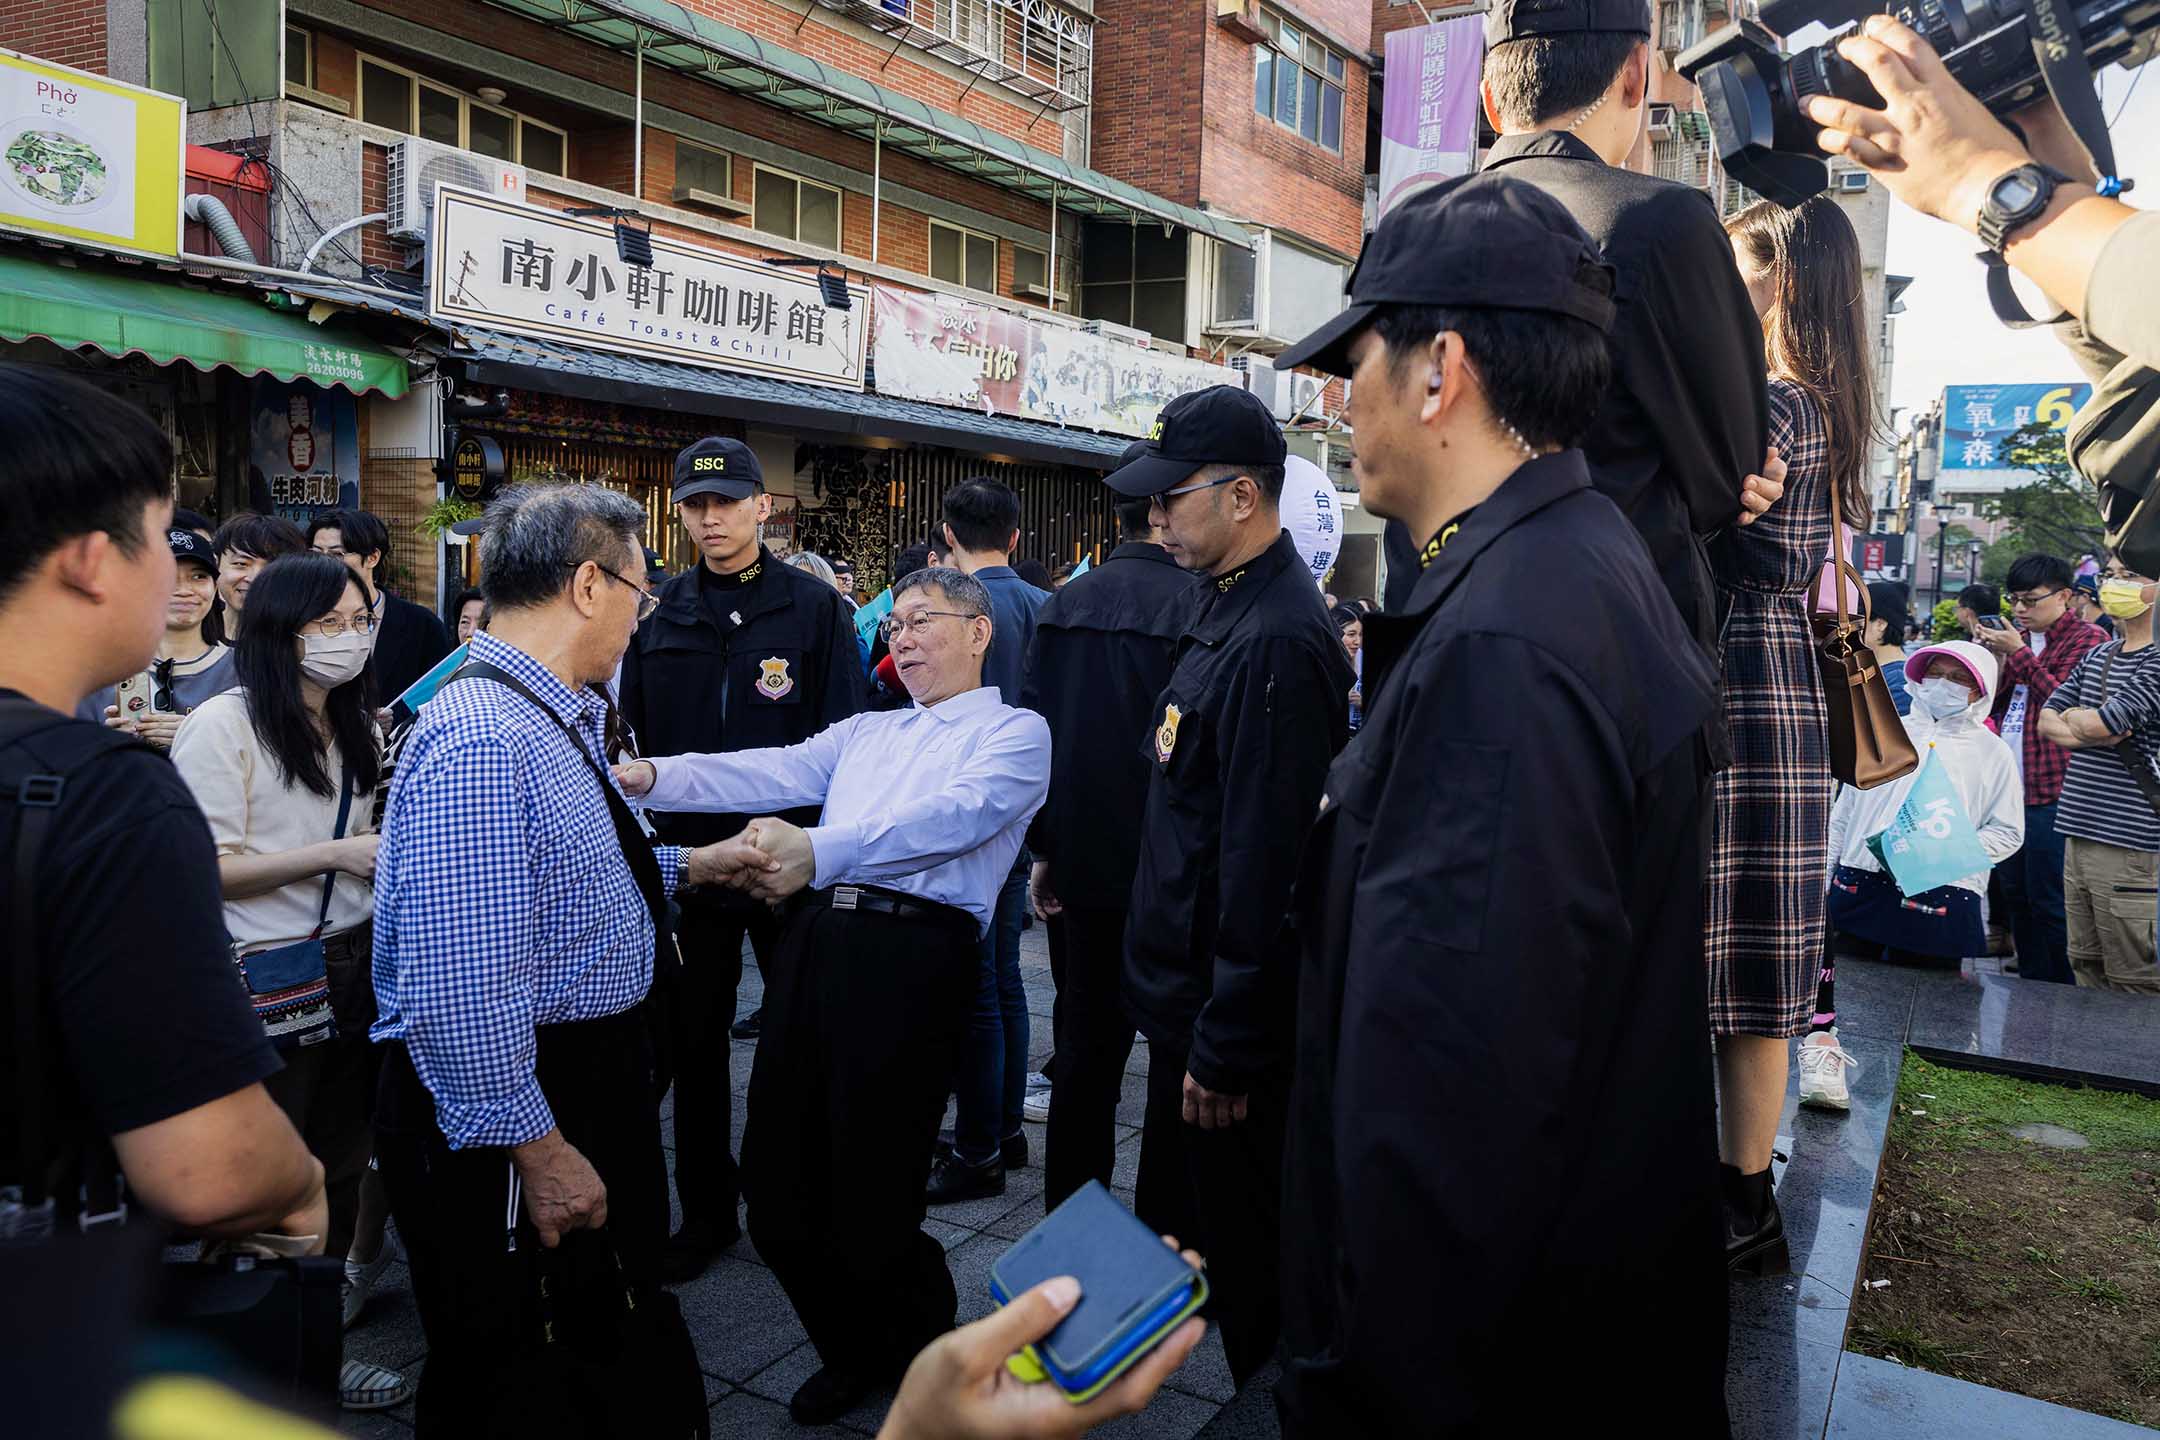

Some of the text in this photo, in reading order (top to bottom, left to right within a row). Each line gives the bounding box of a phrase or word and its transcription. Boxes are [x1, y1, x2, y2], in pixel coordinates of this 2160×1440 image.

[37, 80, 78, 105] Phở
[501, 237, 828, 347] 南小軒咖啡館
[545, 303, 606, 327] Café
[694, 457, 724, 471] SSC
[271, 473, 340, 505] 牛肉河粉
[739, 563, 763, 583] SSC
